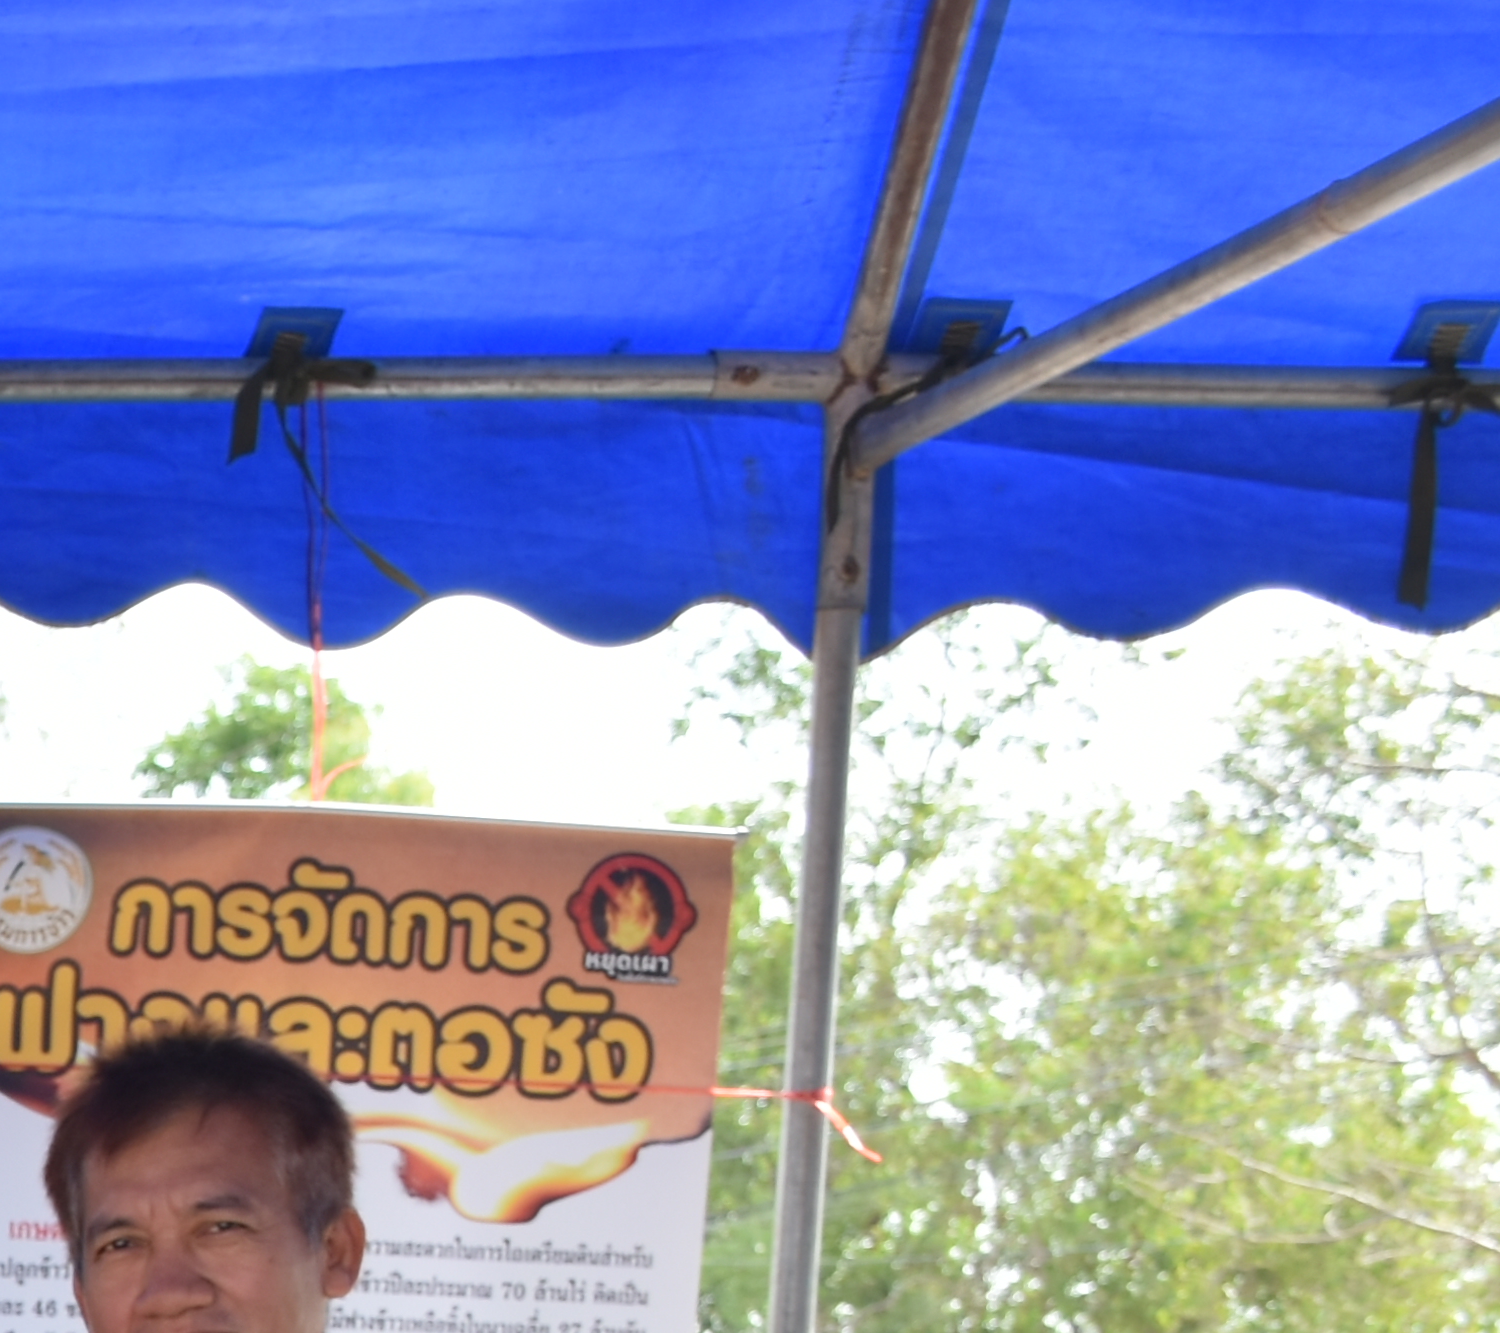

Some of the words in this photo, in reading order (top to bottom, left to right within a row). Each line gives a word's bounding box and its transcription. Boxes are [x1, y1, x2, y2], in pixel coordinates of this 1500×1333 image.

[110, 858, 550, 973] การจัดการ
[33, 1299, 60, 1318] 46
[501, 1281, 526, 1301] 70
